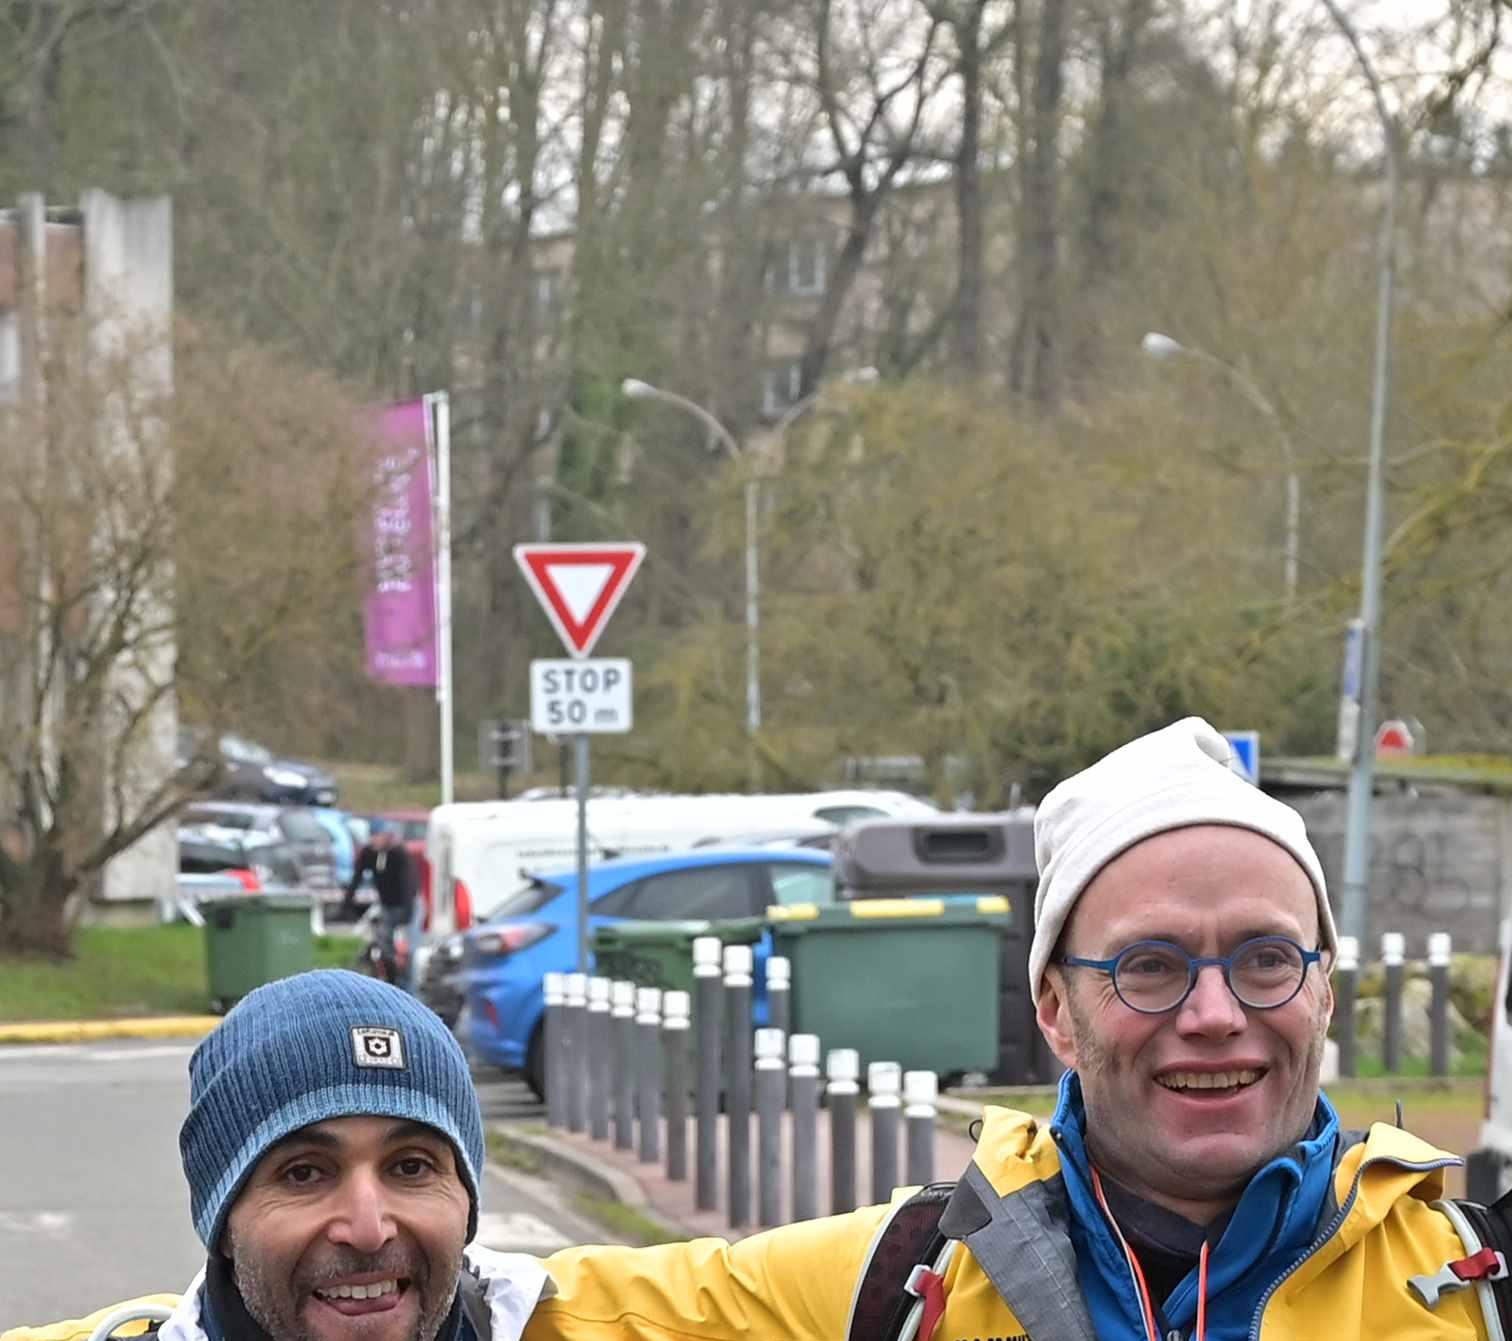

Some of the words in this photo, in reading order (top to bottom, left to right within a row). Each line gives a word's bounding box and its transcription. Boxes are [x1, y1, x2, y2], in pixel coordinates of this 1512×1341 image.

[542, 667, 621, 694] STOP
[546, 700, 587, 724] 50
[594, 709, 618, 723] m
